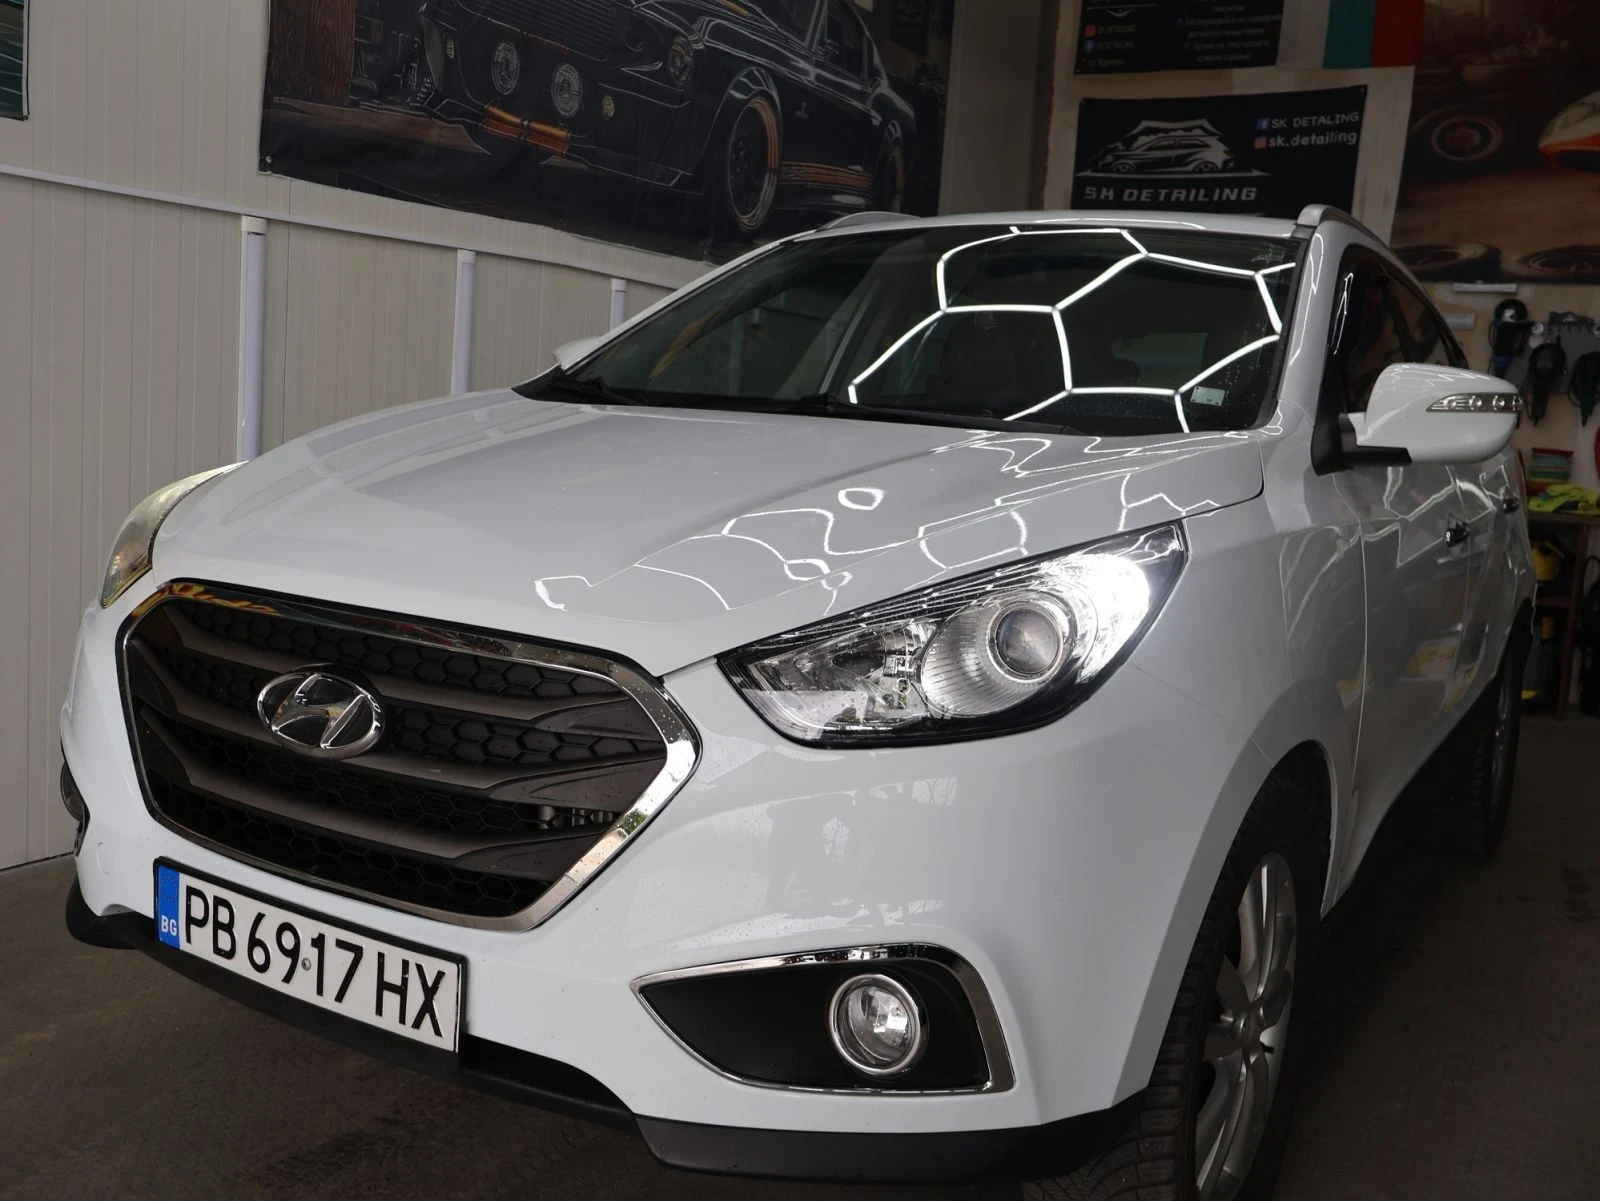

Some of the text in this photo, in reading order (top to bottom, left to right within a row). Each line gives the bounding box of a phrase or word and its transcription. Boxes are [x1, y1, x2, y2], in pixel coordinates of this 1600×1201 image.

[1271, 111, 1360, 129] SK DETALING
[1268, 131, 1358, 148] sk.detailing
[1122, 186, 1258, 202] DETAILING
[161, 915, 178, 937] BG
[185, 884, 446, 1038] PB 6917 HX
